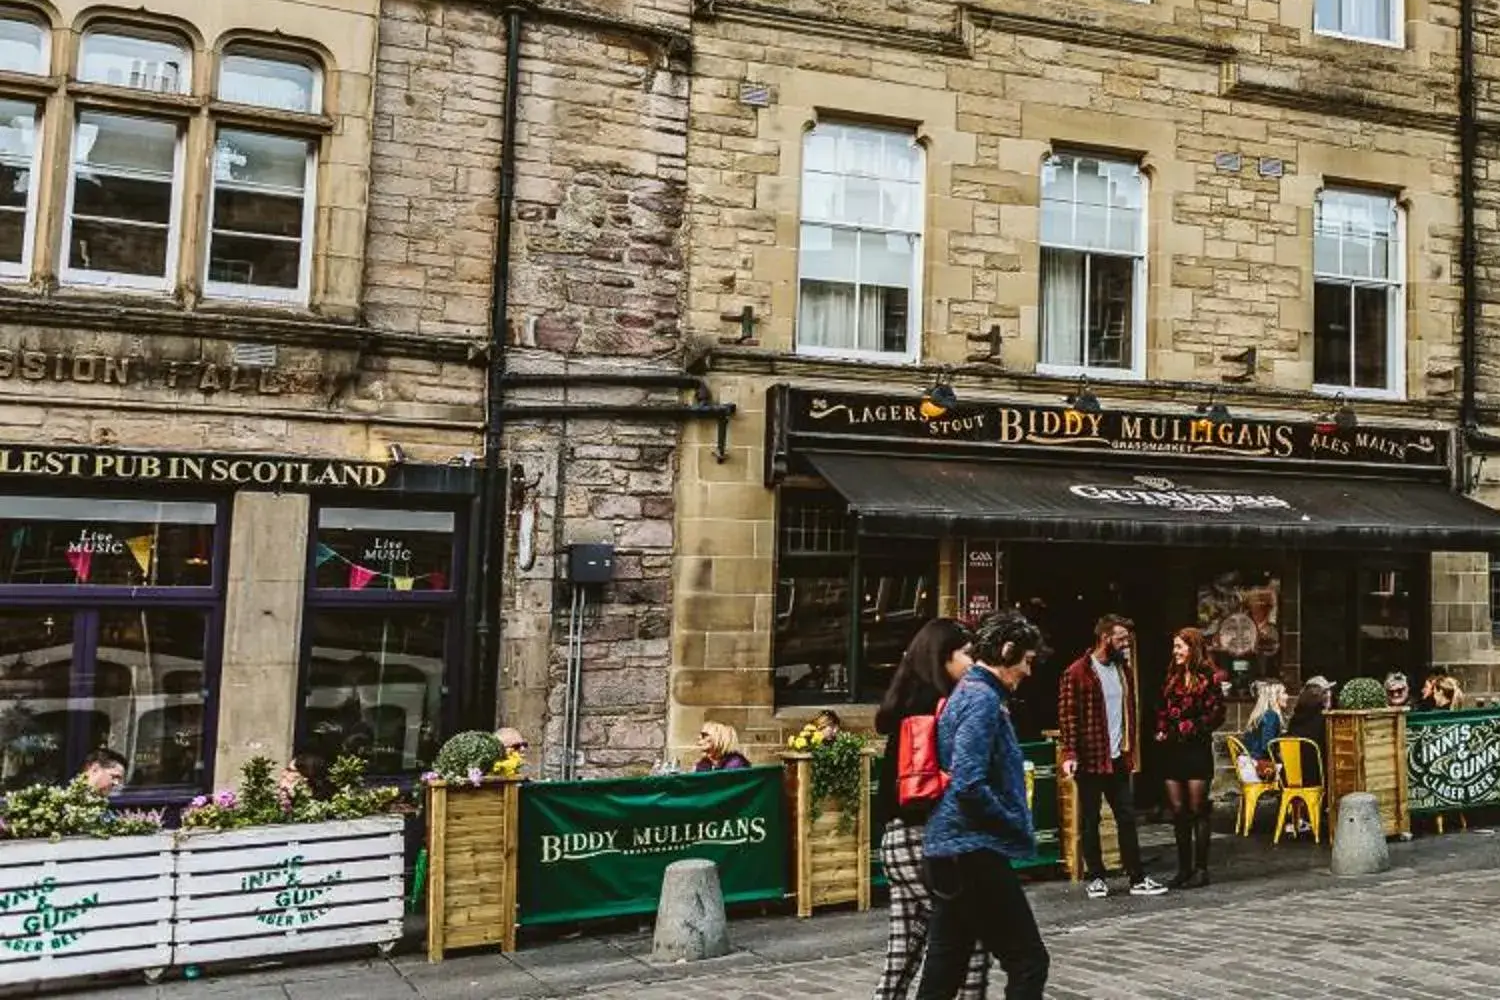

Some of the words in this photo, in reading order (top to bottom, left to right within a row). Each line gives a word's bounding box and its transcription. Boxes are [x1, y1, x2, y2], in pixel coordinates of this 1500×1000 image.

[848, 405, 929, 424] LAGERS
[929, 415, 985, 435] STOUT
[1000, 407, 1102, 443] BIDDY
[1120, 415, 1293, 457] MULLIGANS
[1310, 433, 1350, 454] ALES
[1355, 433, 1406, 458] MALTS
[94, 453, 162, 478] PUB
[168, 457, 206, 480] IN
[211, 459, 388, 486] SCOTLAND
[67, 541, 123, 554] MUSIC
[80, 529, 113, 543] Live
[363, 549, 412, 561] MUSIC
[1421, 724, 1471, 764] INNIS
[1457, 743, 1469, 760] &
[1450, 741, 1500, 780] GUNN
[1431, 776, 1465, 799] LAGER
[1467, 773, 1496, 797] BEER
[540, 829, 619, 863] BIDDY
[632, 817, 768, 847] MULLIGANS
